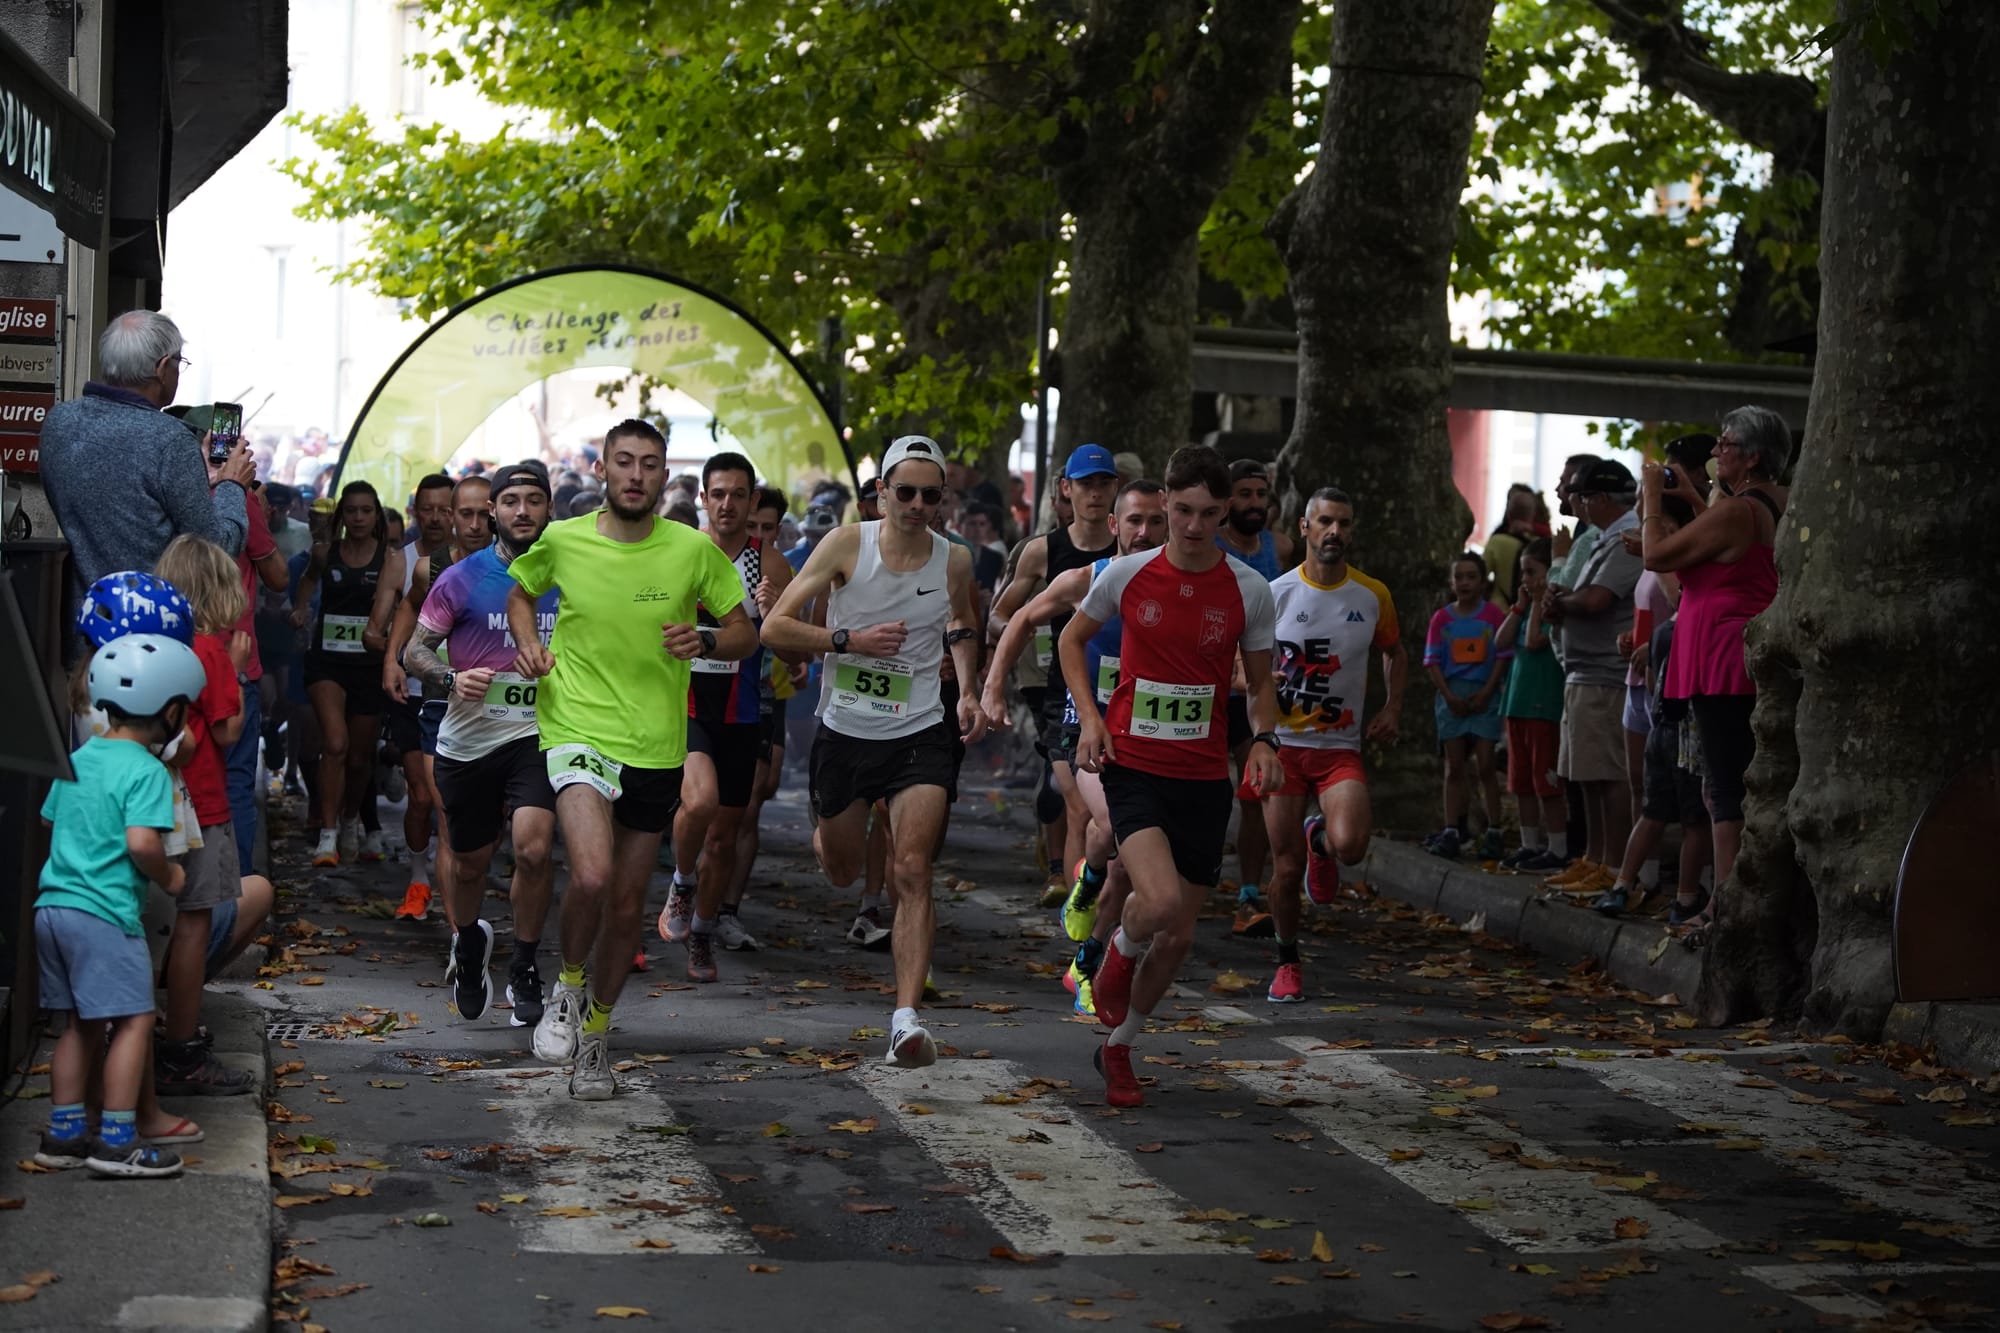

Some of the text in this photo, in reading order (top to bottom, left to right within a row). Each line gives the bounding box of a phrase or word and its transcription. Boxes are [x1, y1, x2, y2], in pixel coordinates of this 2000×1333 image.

[485, 302, 681, 334] Challenge des
[473, 335, 567, 356] vallées
[0, 404, 46, 422] urre
[335, 625, 357, 641] 21
[855, 670, 891, 697] 53
[505, 686, 538, 705] 60
[1146, 697, 1202, 722] 113
[569, 754, 604, 777] 43
